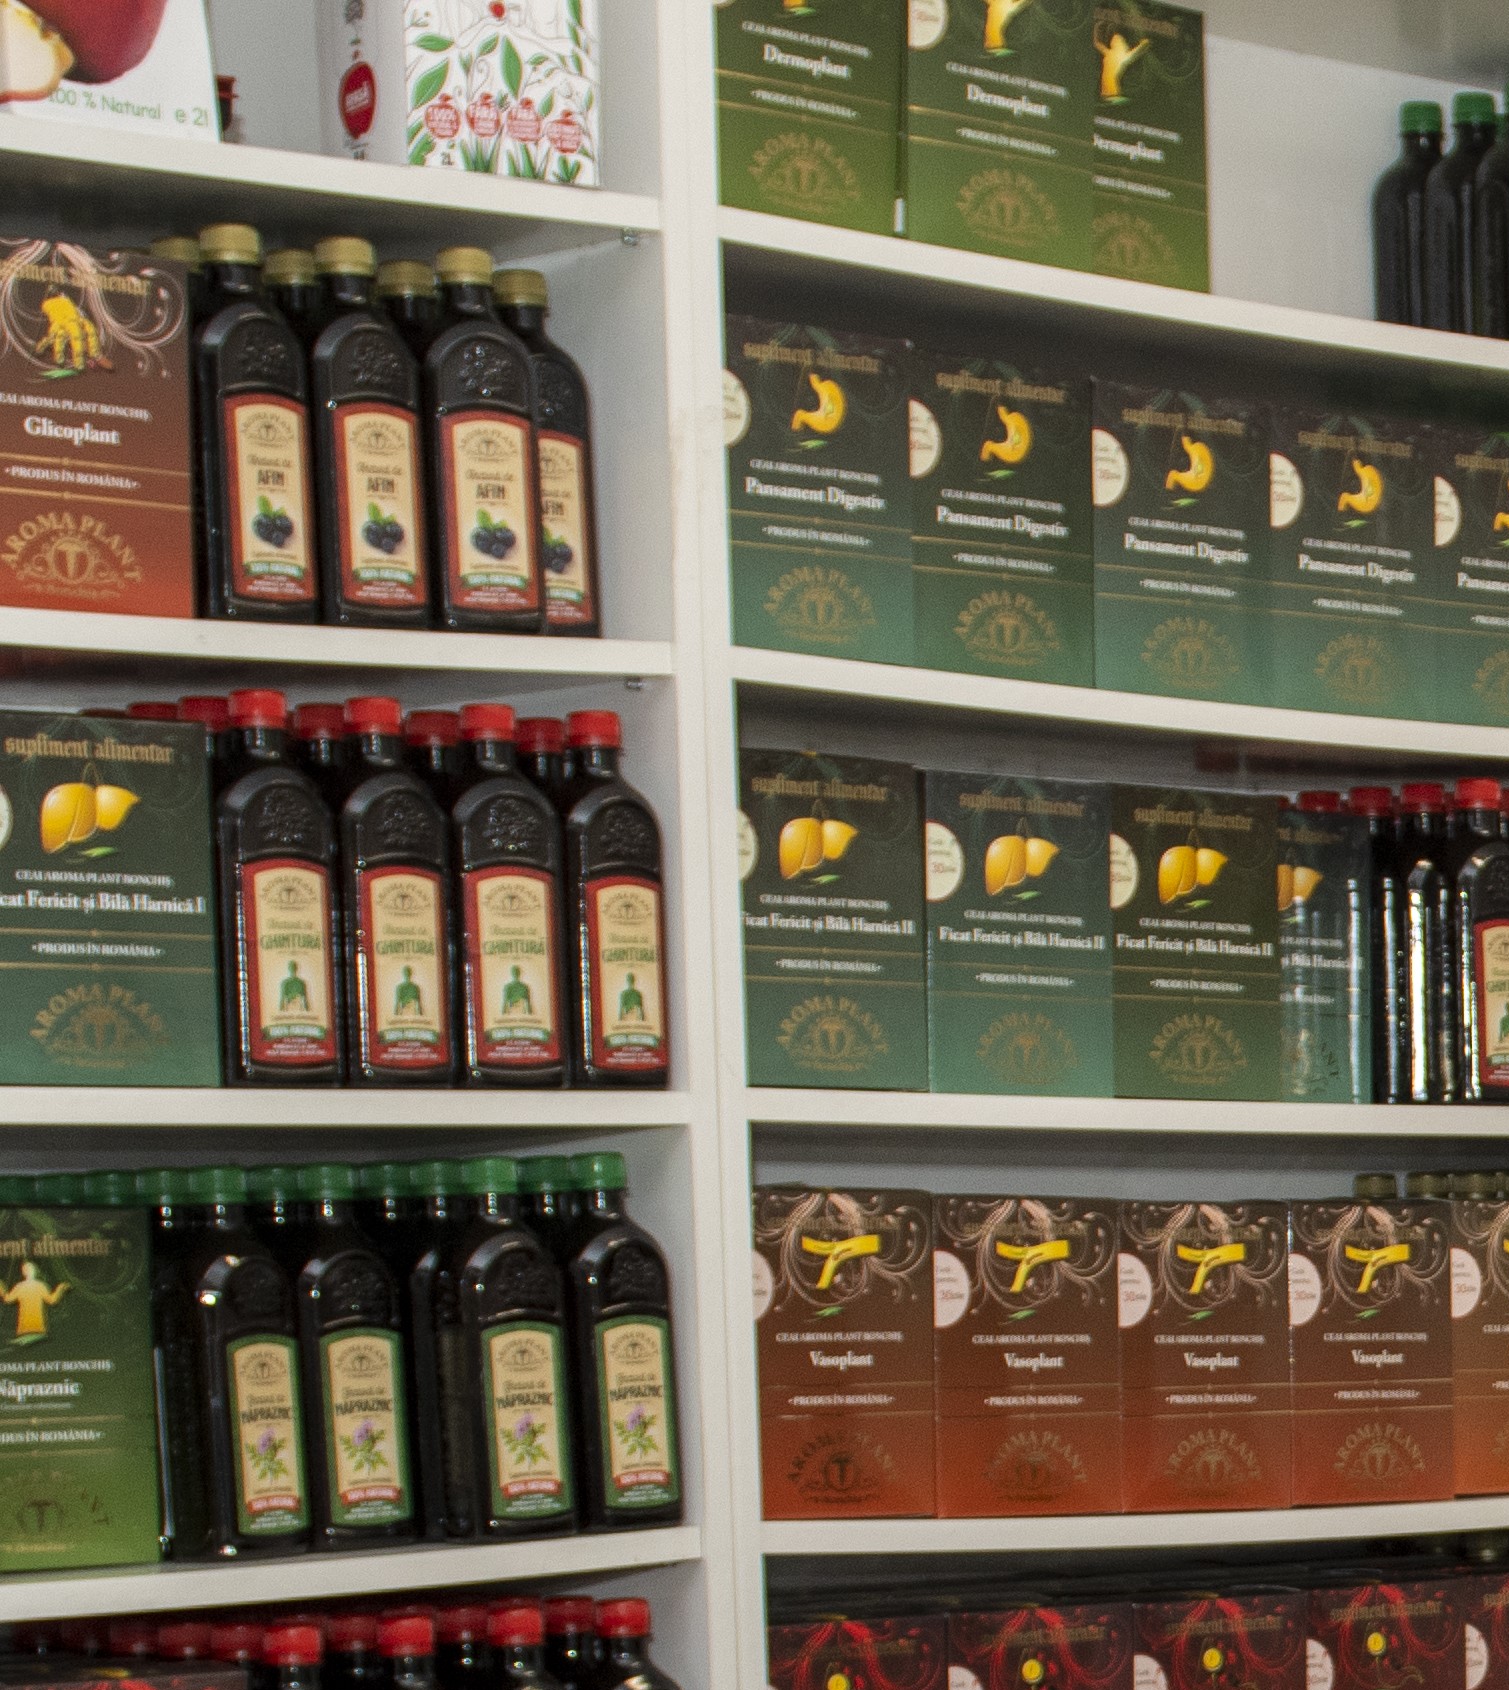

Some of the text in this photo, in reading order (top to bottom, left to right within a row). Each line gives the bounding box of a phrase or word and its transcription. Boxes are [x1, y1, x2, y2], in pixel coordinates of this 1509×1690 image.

[763, 43, 850, 78] Dermoplant
[81, 95, 97, 109] %
[101, 96, 161, 121] Natural
[966, 83, 1050, 118] Dermoplant
[0, 393, 20, 404] EAI
[24, 416, 121, 446] Glicoplant
[12, 465, 60, 483] PRODUS
[257, 469, 285, 487] AFIN
[366, 476, 395, 495] AFIN
[475, 483, 506, 502] AFIN
[745, 477, 885, 511] Pansament Digestiv
[937, 505, 1068, 538] Pansament Digestiv
[1, 511, 143, 582] AROMA PLANT
[1124, 533, 1250, 565] Pansament Digestiv
[1299, 554, 1365, 578] Pansament
[15, 869, 44, 882] CEAI
[27, 889, 79, 910] Fericit
[98, 891, 128, 912] Bilă
[133, 894, 191, 914] Harnică
[940, 926, 974, 944] Ficat
[1116, 933, 1146, 950] Ficat
[37, 943, 82, 956] PRODUS
[810, 1350, 873, 1370] Vasoplant
[1004, 1352, 1063, 1370] Vasoplant
[1184, 1352, 1240, 1369] Vasoplant
[1352, 1349, 1404, 1366] Vasoplant
